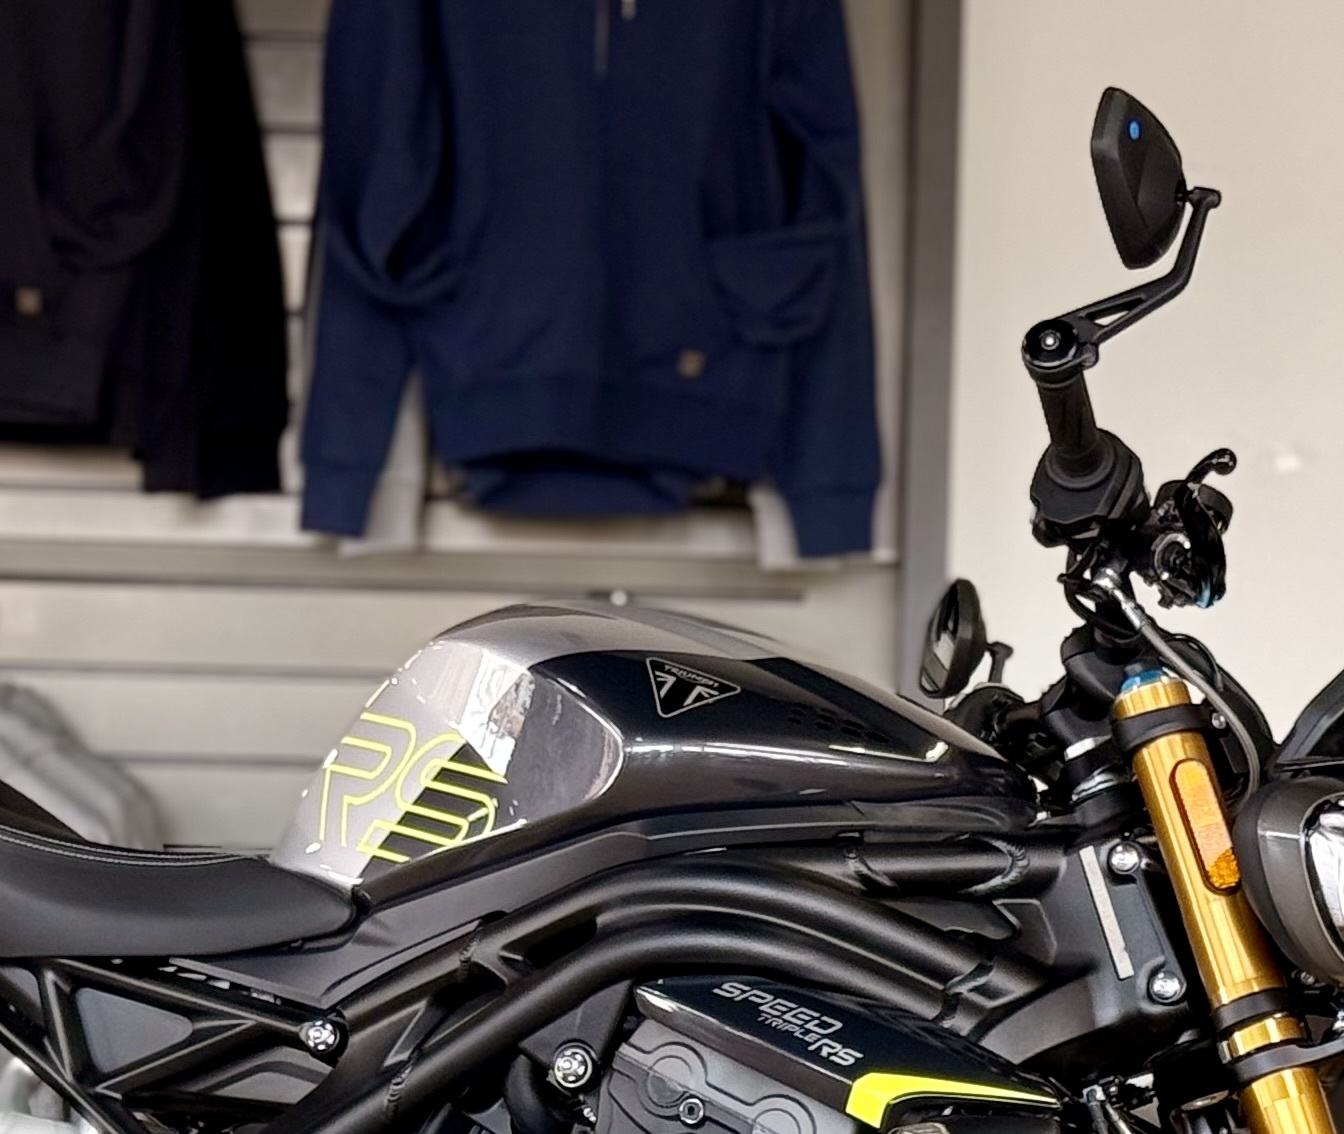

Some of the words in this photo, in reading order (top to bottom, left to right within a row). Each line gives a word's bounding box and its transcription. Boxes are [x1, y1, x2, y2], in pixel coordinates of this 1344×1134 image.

[320, 711, 508, 864] RS
[712, 982, 843, 1035] SPEED
[757, 1013, 822, 1043] TRIPLE
[808, 1038, 864, 1066] RS
